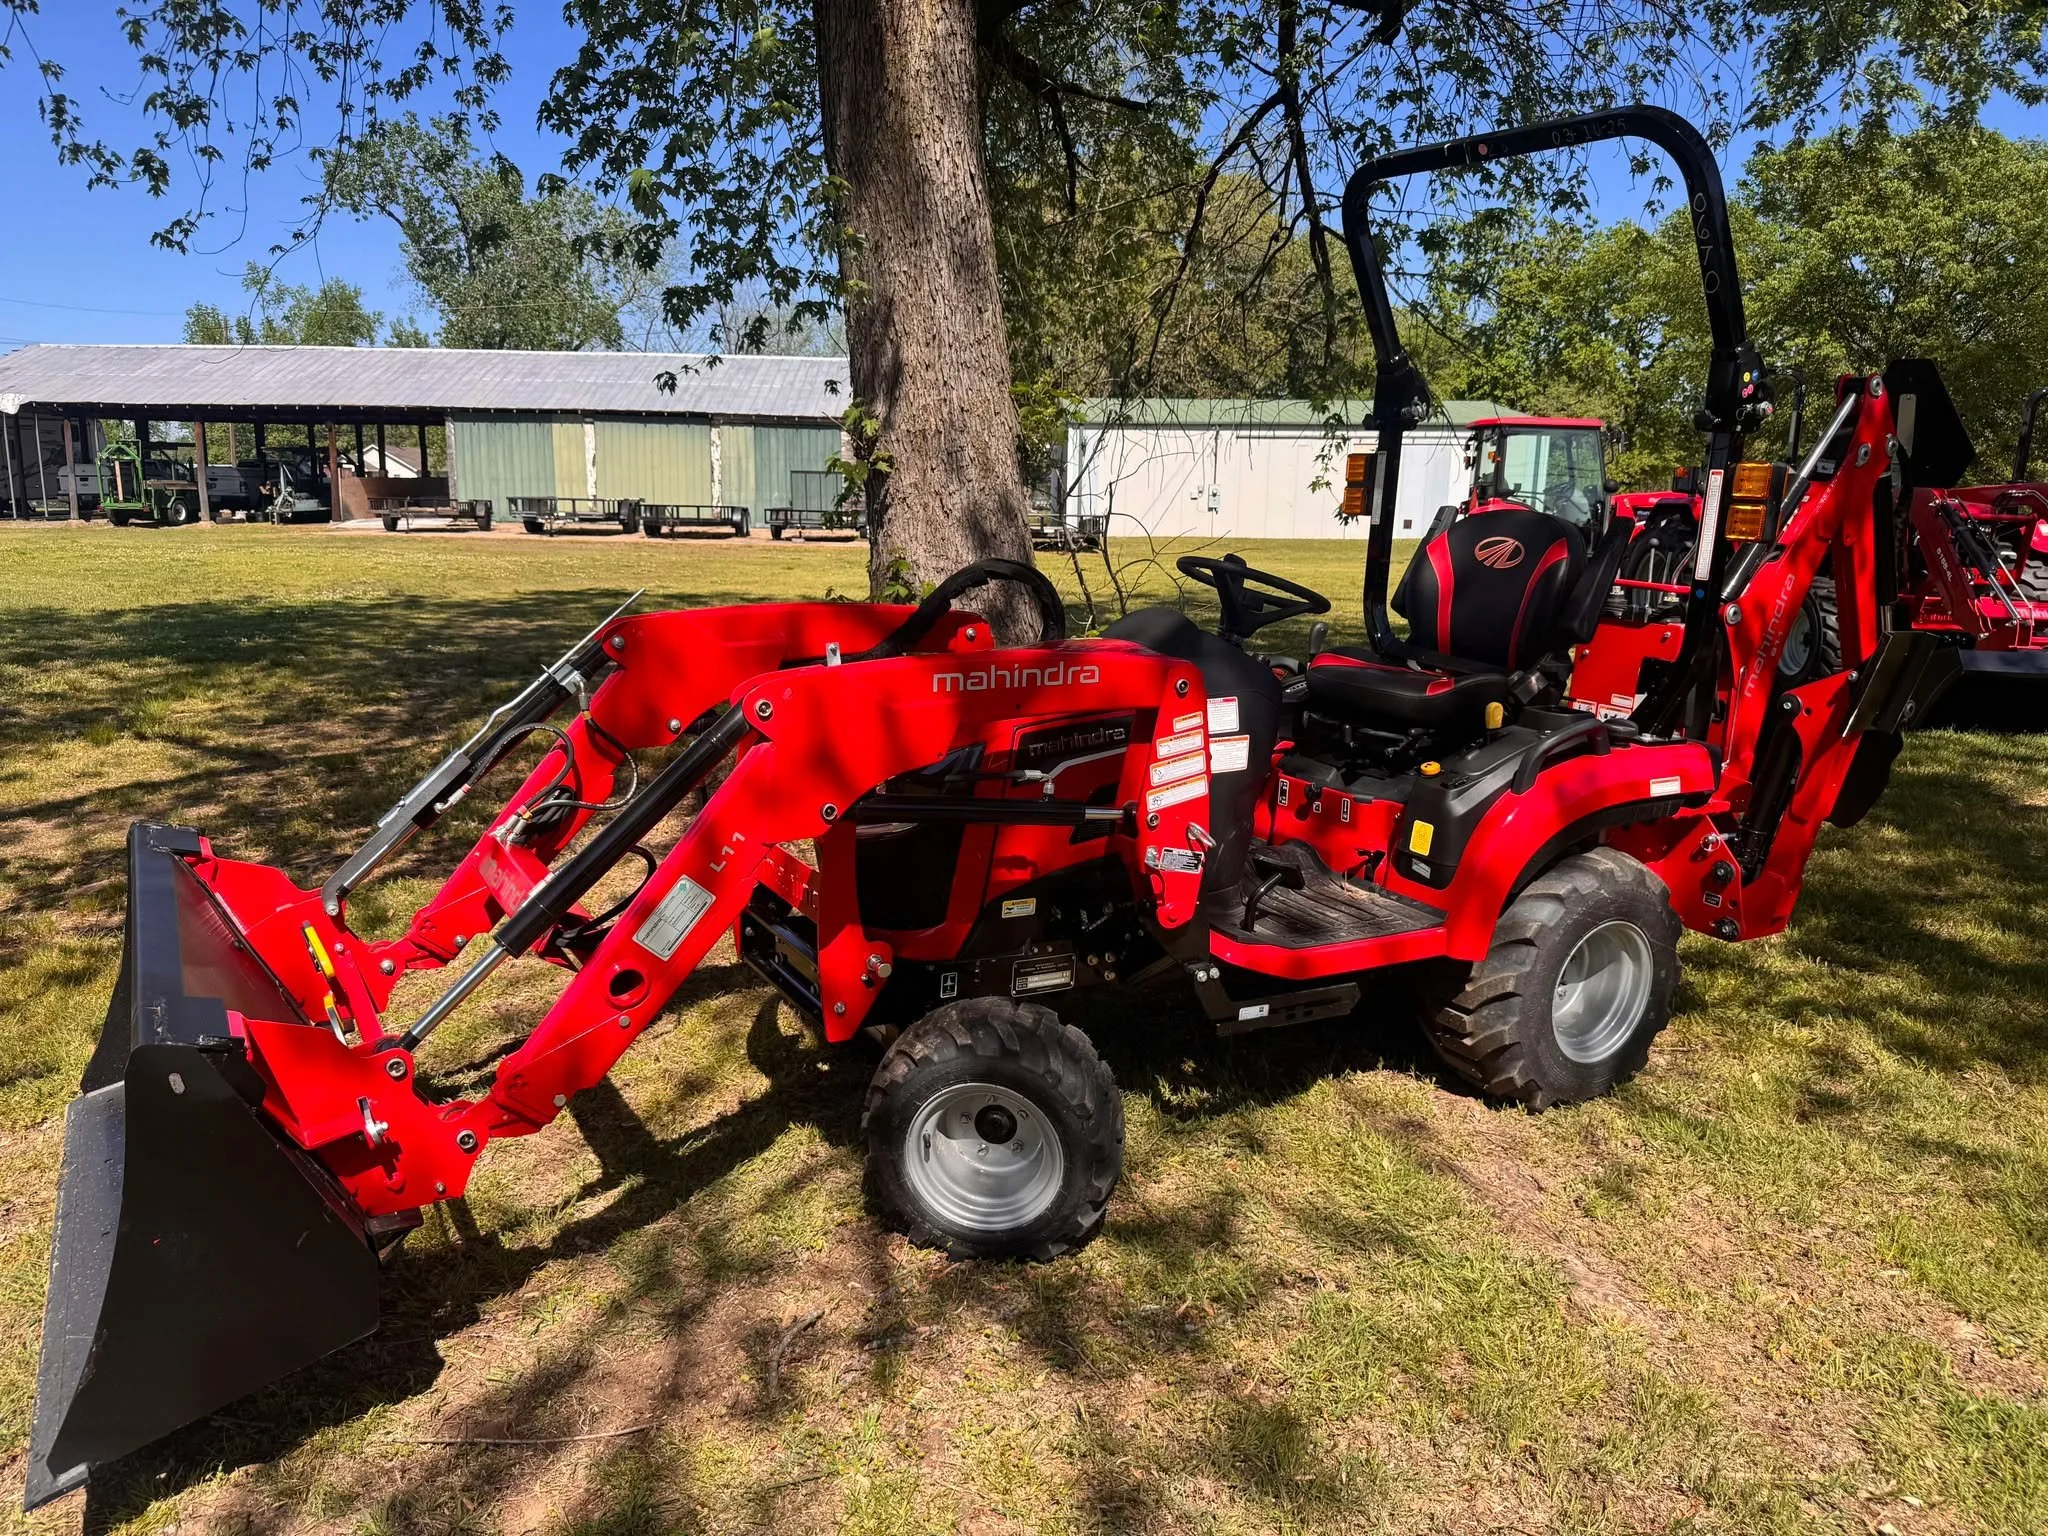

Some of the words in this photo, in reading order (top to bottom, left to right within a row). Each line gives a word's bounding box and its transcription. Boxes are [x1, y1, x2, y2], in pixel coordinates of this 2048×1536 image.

[1693, 193, 1720, 294] 0670
[1744, 573, 1796, 697] mahindra
[932, 661, 1100, 693] mahindra
[1029, 728, 1126, 756] mahindra
[709, 832, 746, 872] L11
[479, 856, 527, 913] mahind
